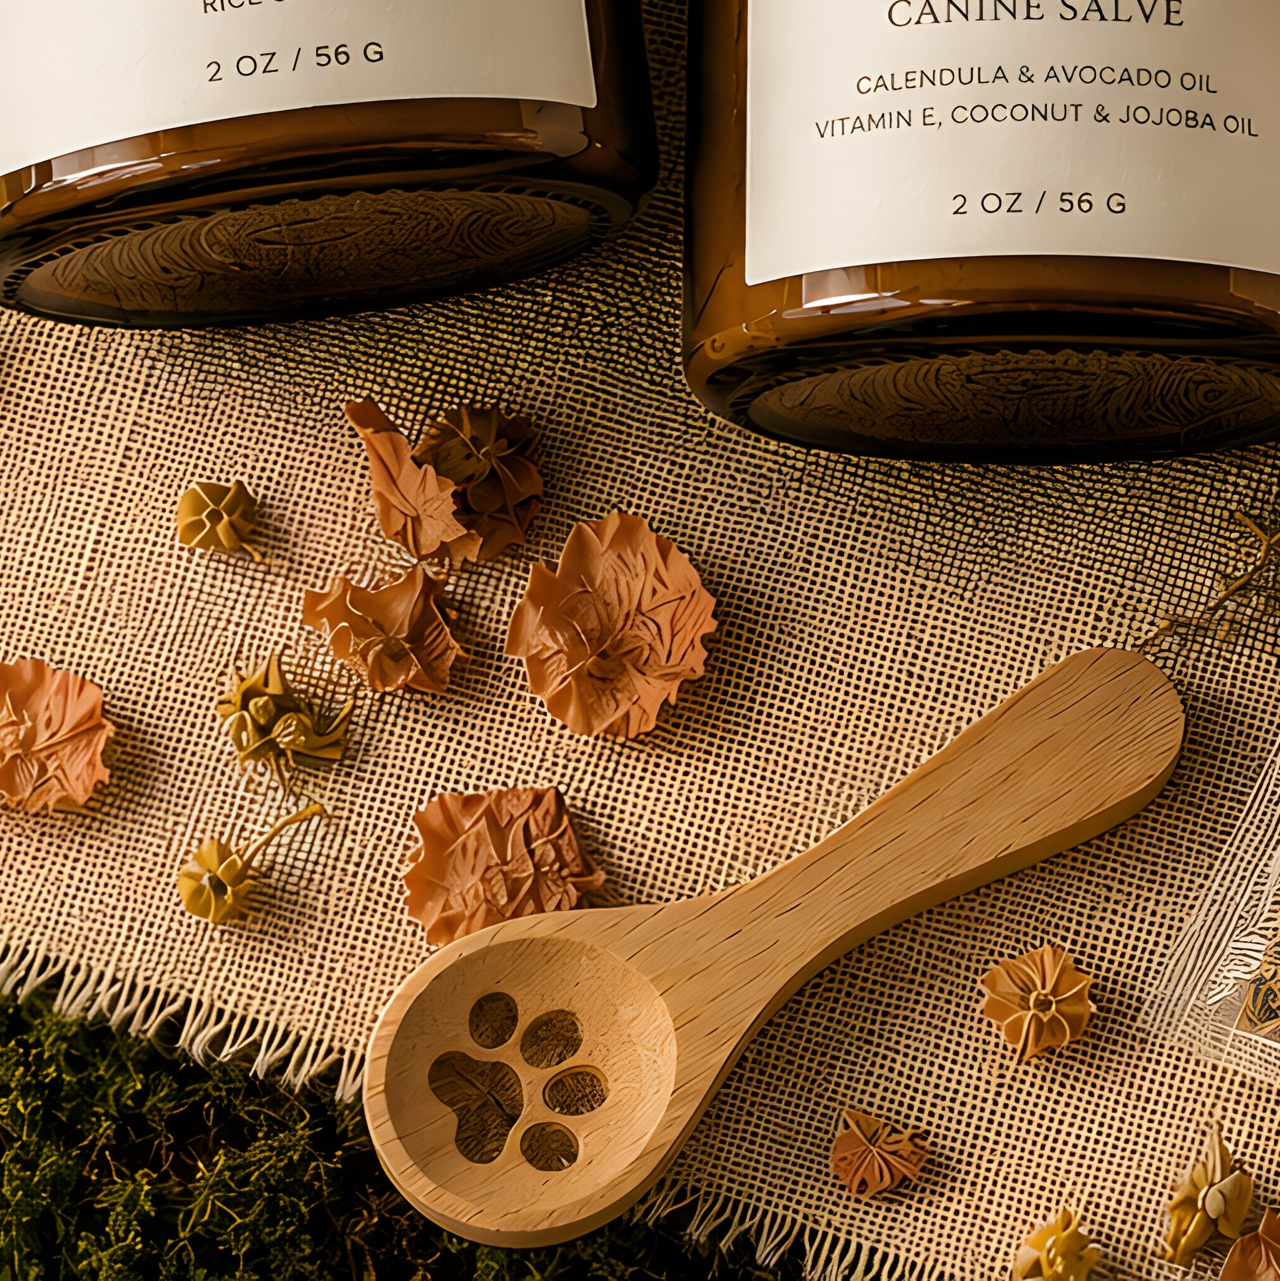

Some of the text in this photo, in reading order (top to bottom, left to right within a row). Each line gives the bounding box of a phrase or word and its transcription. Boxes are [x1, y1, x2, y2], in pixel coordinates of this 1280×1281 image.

[206, 42, 383, 82] 2 OZ / 56 G
[856, 65, 1217, 94] CALENDULA & AVOCADO OIL
[815, 103, 1258, 138] VITAMIN E, COCONUT & JOJOBA OIL
[953, 190, 1125, 215] 2 OZ / 56 G
